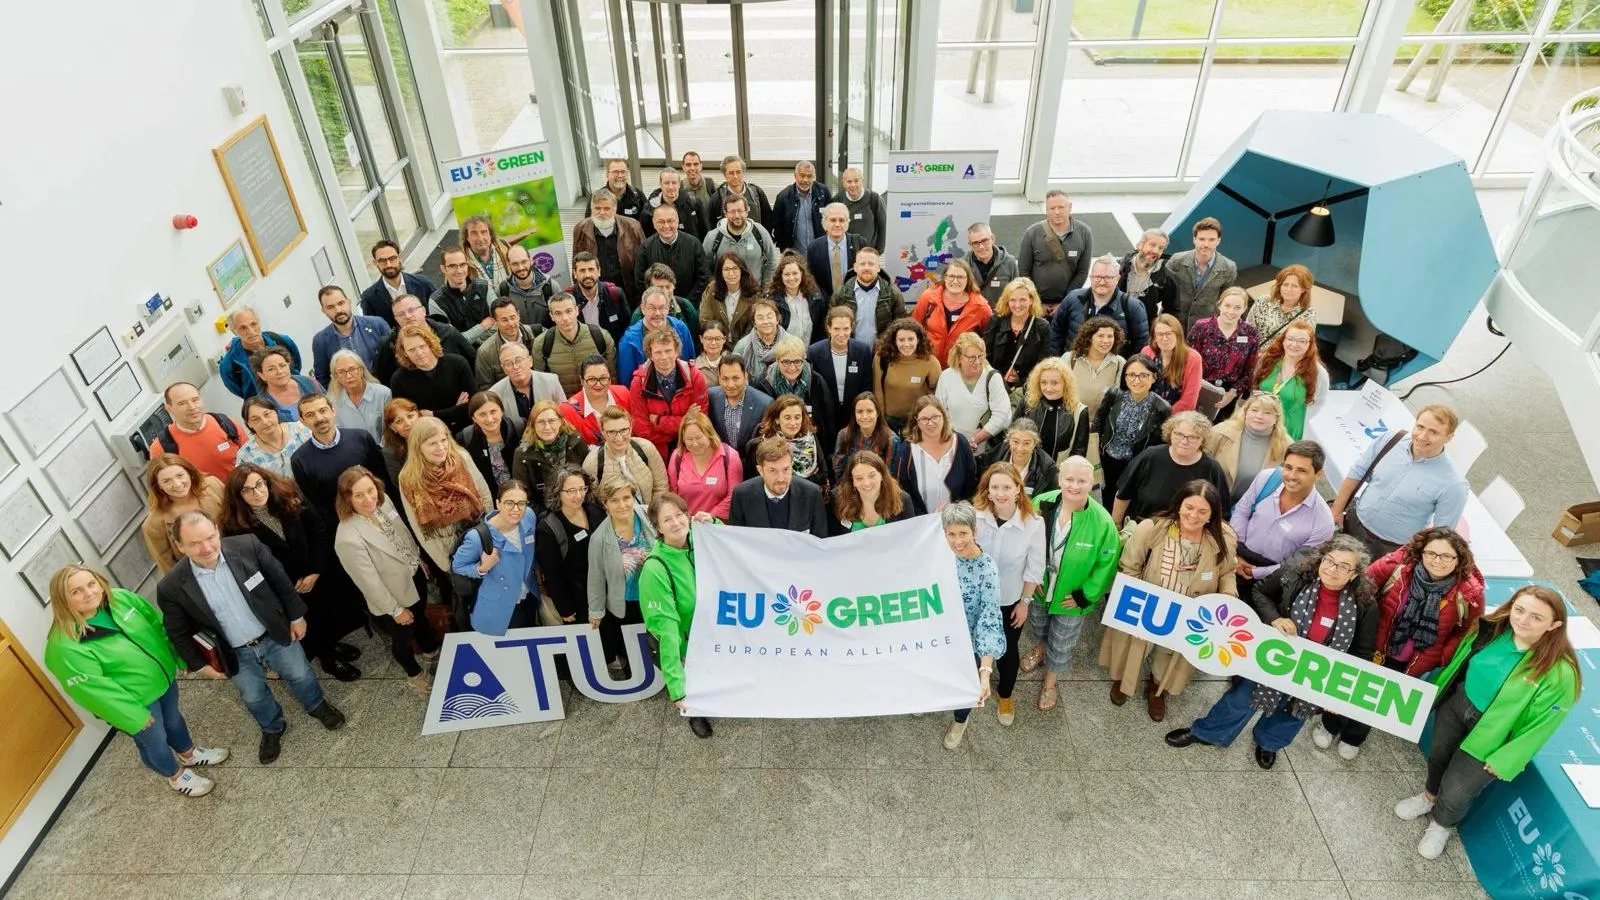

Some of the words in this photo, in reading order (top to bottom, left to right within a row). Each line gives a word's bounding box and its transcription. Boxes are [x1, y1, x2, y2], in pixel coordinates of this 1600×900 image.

[450, 166, 472, 182] EU
[497, 151, 544, 171] GREEN
[896, 165, 909, 173] EU
[924, 164, 954, 172] GREEN
[716, 590, 766, 628] EU
[825, 582, 945, 629] GREEN
[714, 643, 829, 657] EUROPEAN
[845, 635, 952, 657] ALLIANCE
[1113, 584, 1183, 637] EU
[1255, 638, 1424, 726] GREEN
[439, 633, 656, 723] ATU
[1507, 796, 1541, 845] EU
